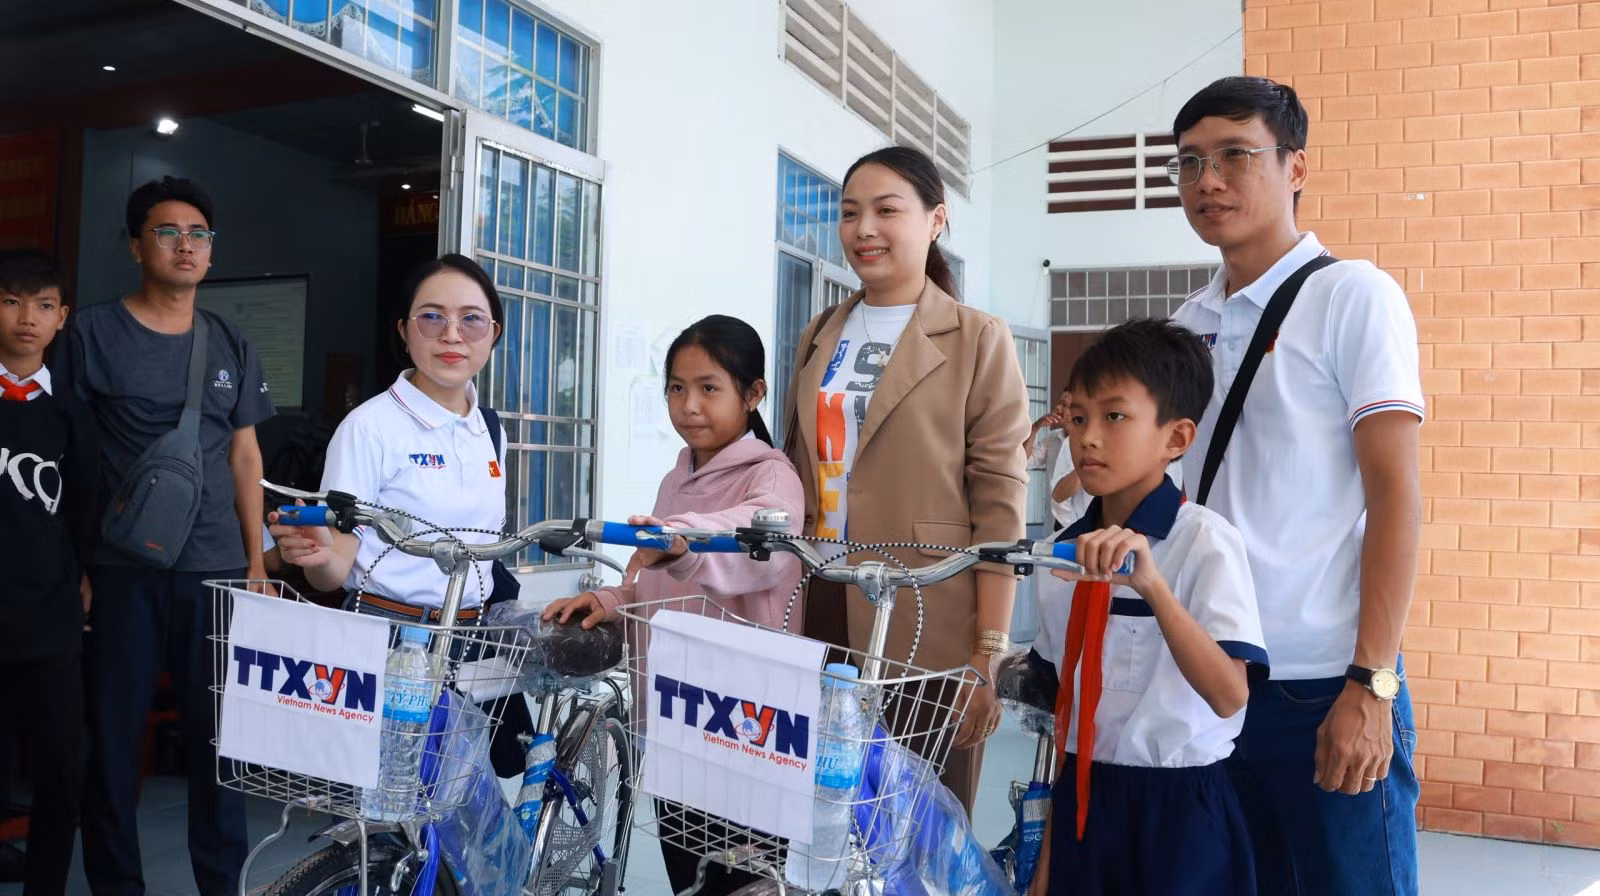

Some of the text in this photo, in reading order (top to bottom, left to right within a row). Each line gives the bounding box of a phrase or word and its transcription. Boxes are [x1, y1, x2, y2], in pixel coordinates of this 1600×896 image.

[234, 645, 376, 713] TTXVN
[277, 695, 374, 724] Vietnam News Agency
[655, 674, 809, 760] TTXVN
[703, 731, 808, 772] Vietnam News Agency
